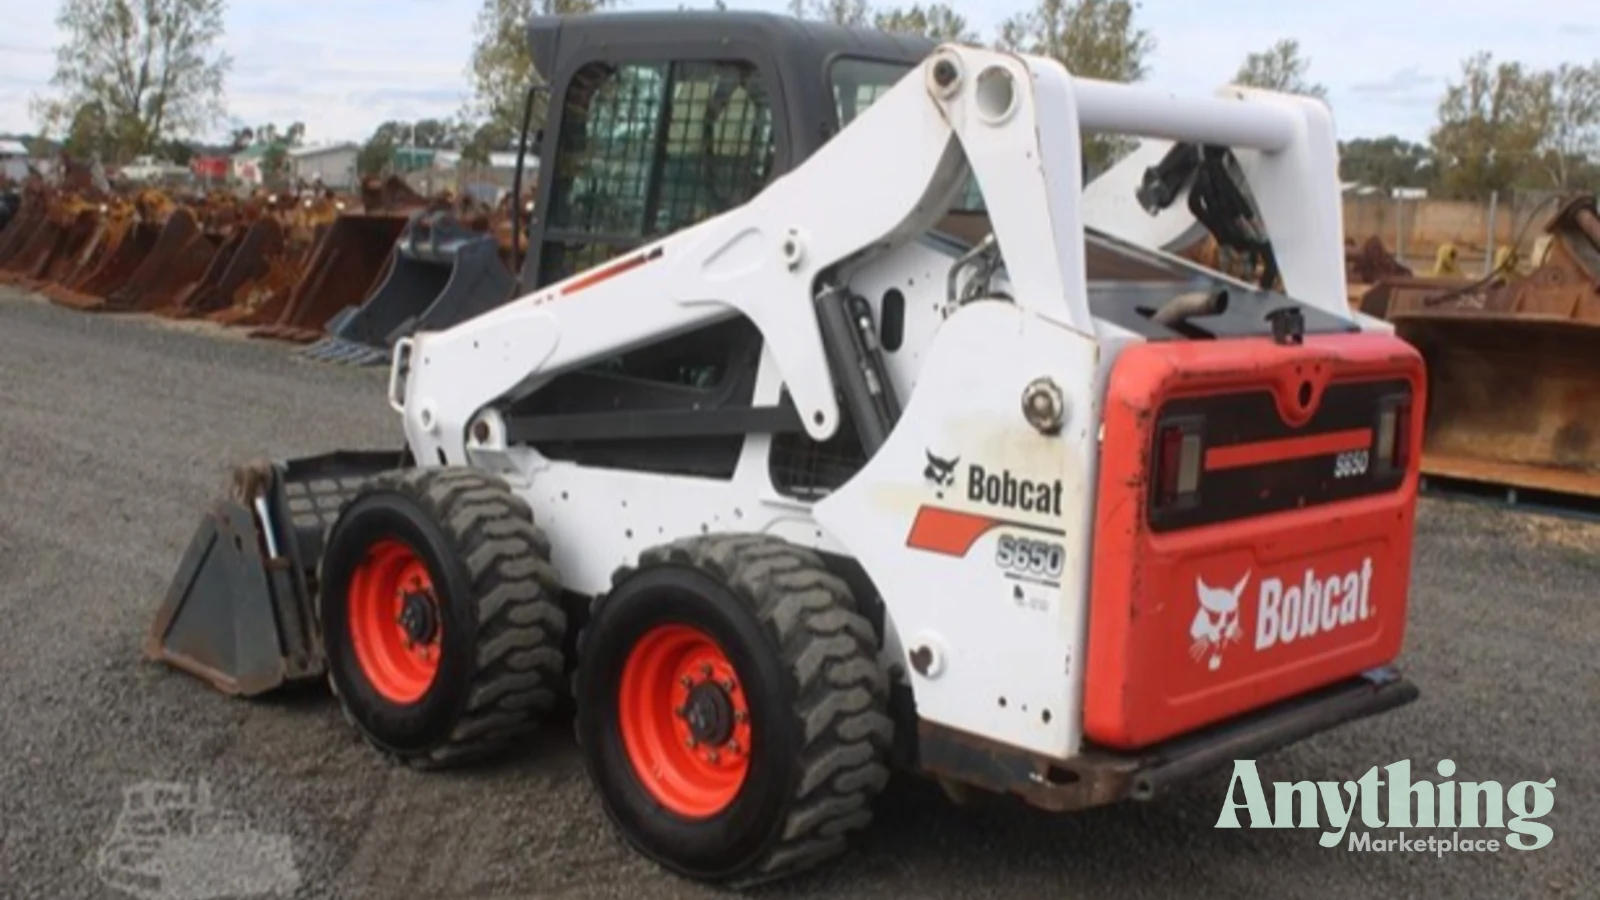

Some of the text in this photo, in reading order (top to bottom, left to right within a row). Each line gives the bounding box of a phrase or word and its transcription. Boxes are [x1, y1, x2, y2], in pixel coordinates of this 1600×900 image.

[967, 465, 1063, 516] Bobcat
[996, 533, 1066, 578] S650
[1255, 557, 1373, 651] Bobcat
